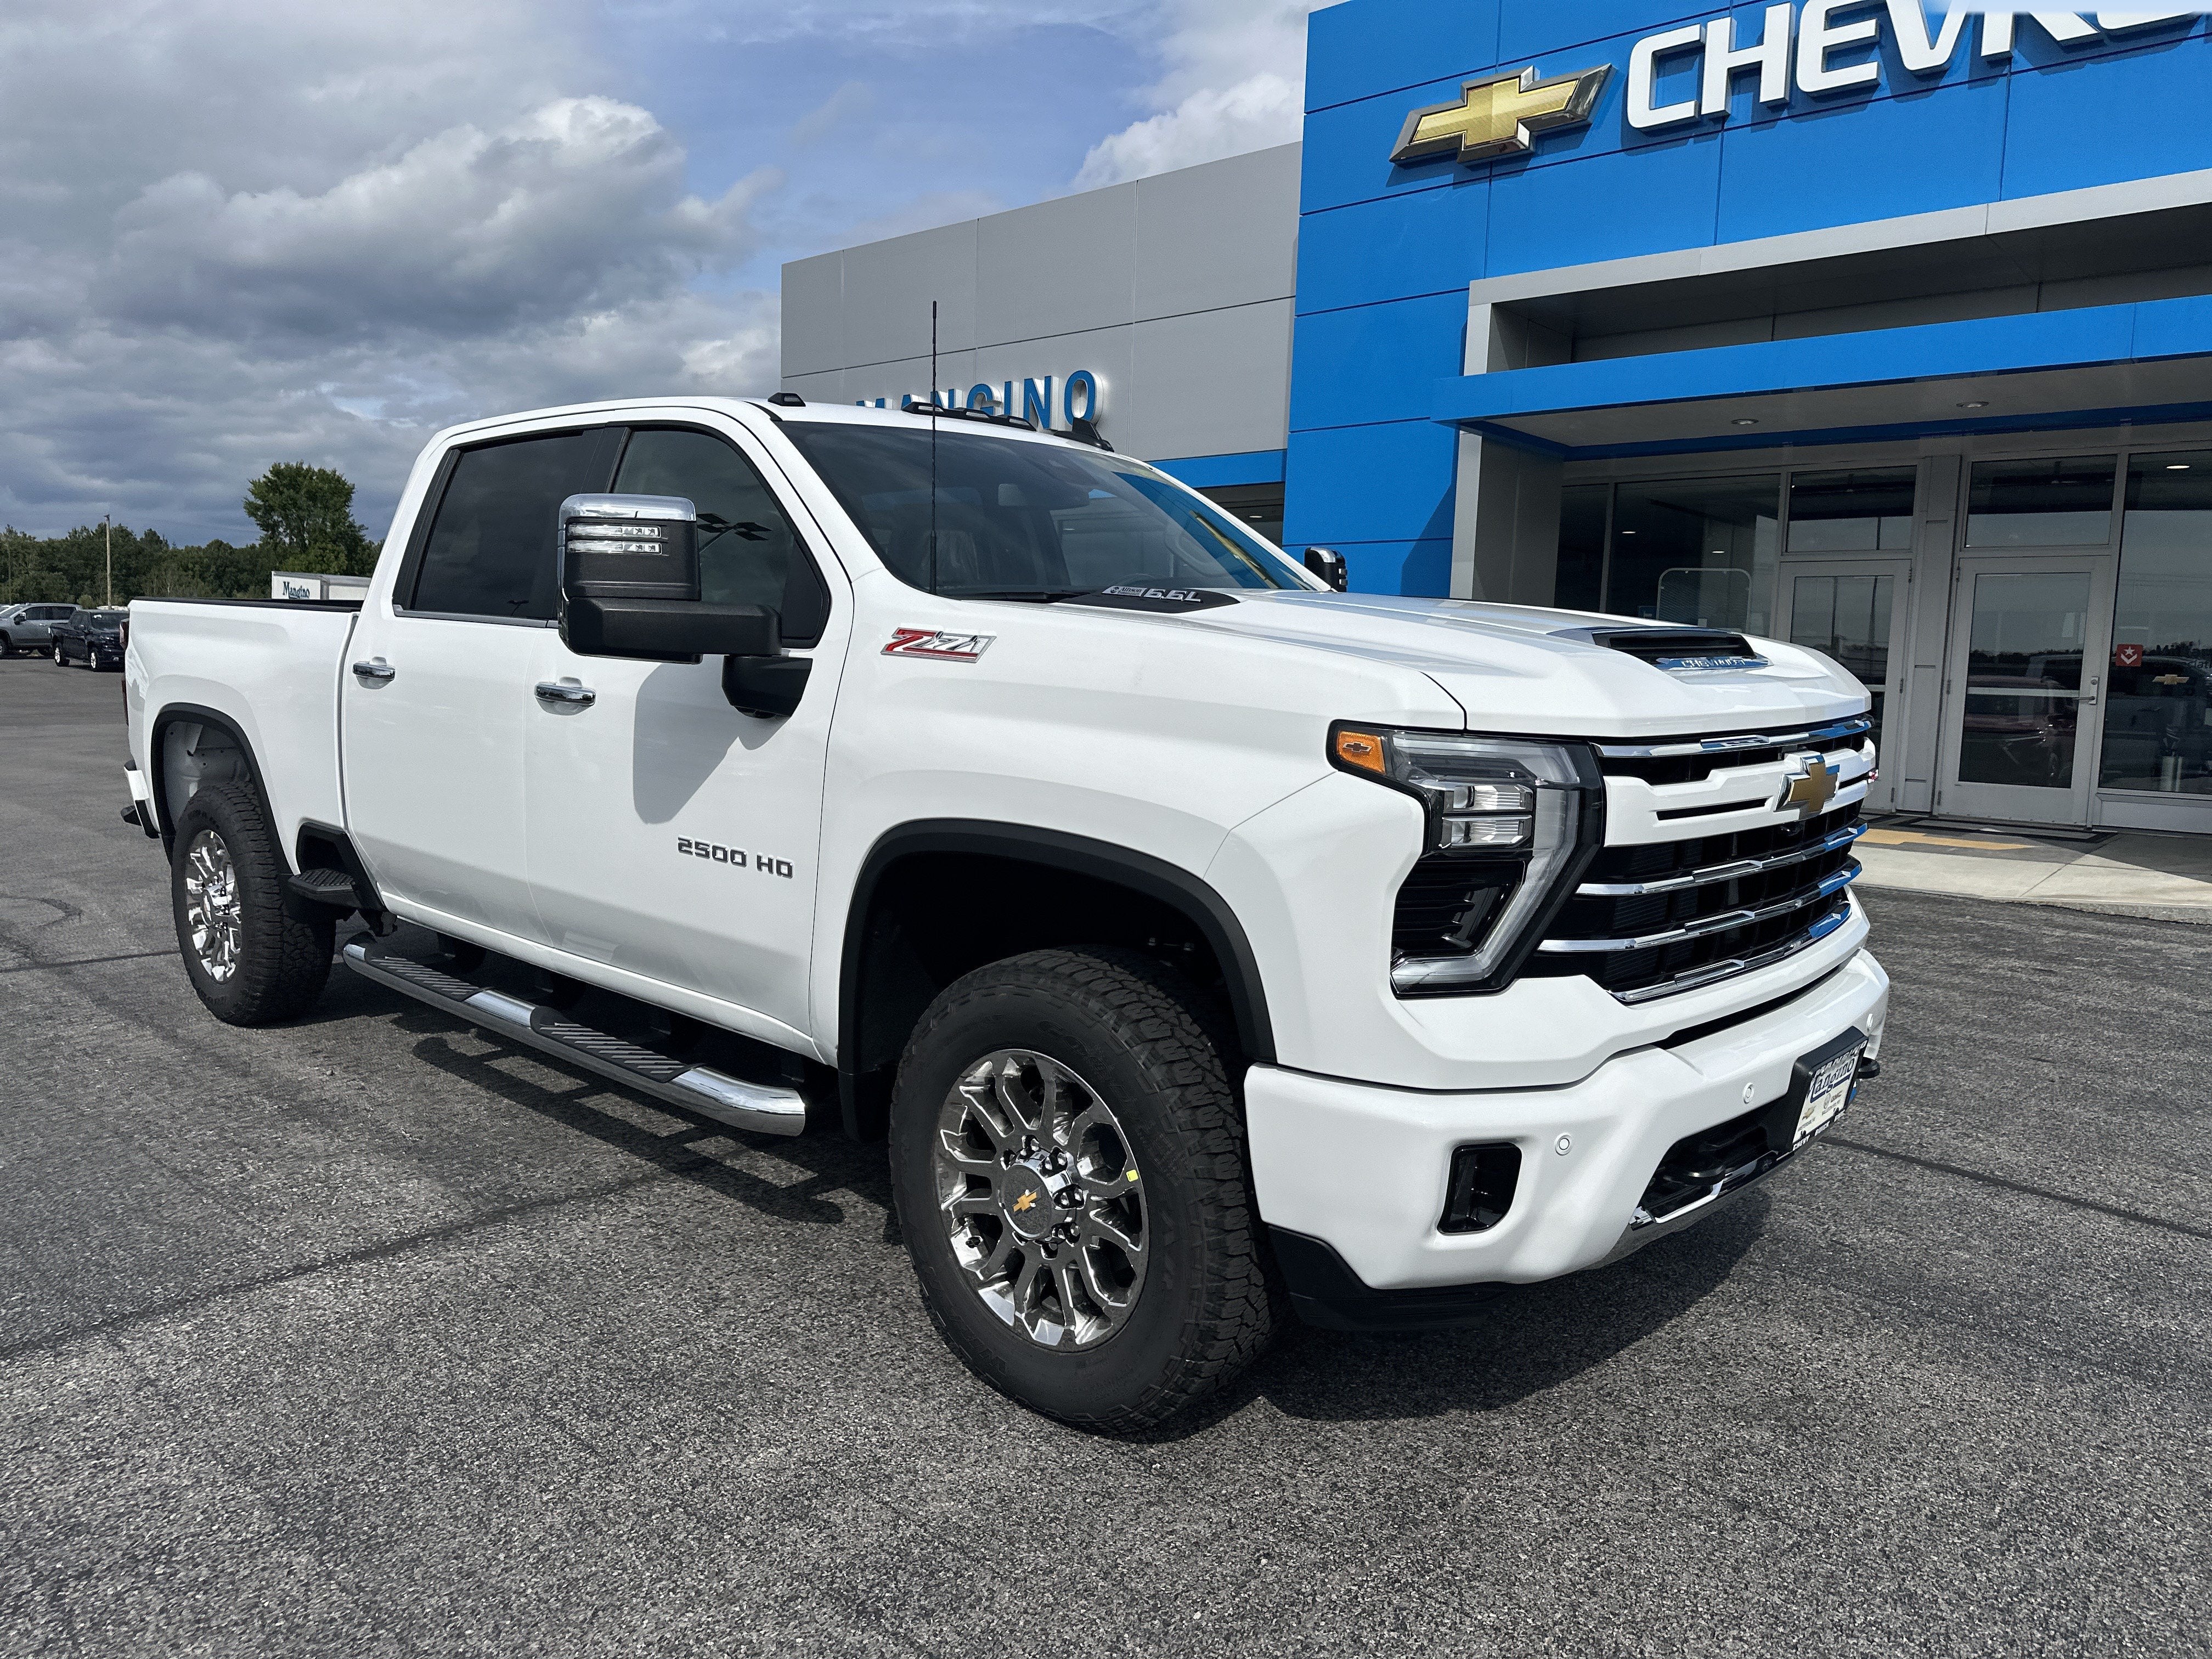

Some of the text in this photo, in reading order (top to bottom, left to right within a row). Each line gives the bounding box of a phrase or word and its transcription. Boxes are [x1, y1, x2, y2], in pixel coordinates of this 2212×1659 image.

[1627, 0, 2196, 128] CHEV
[283, 581, 310, 600] Mangino
[1143, 588, 1201, 602] 6.6L
[880, 627, 996, 664] Z71
[678, 836, 794, 879] 2500 HD
[1792, 1135, 1810, 1151] CHEVY
